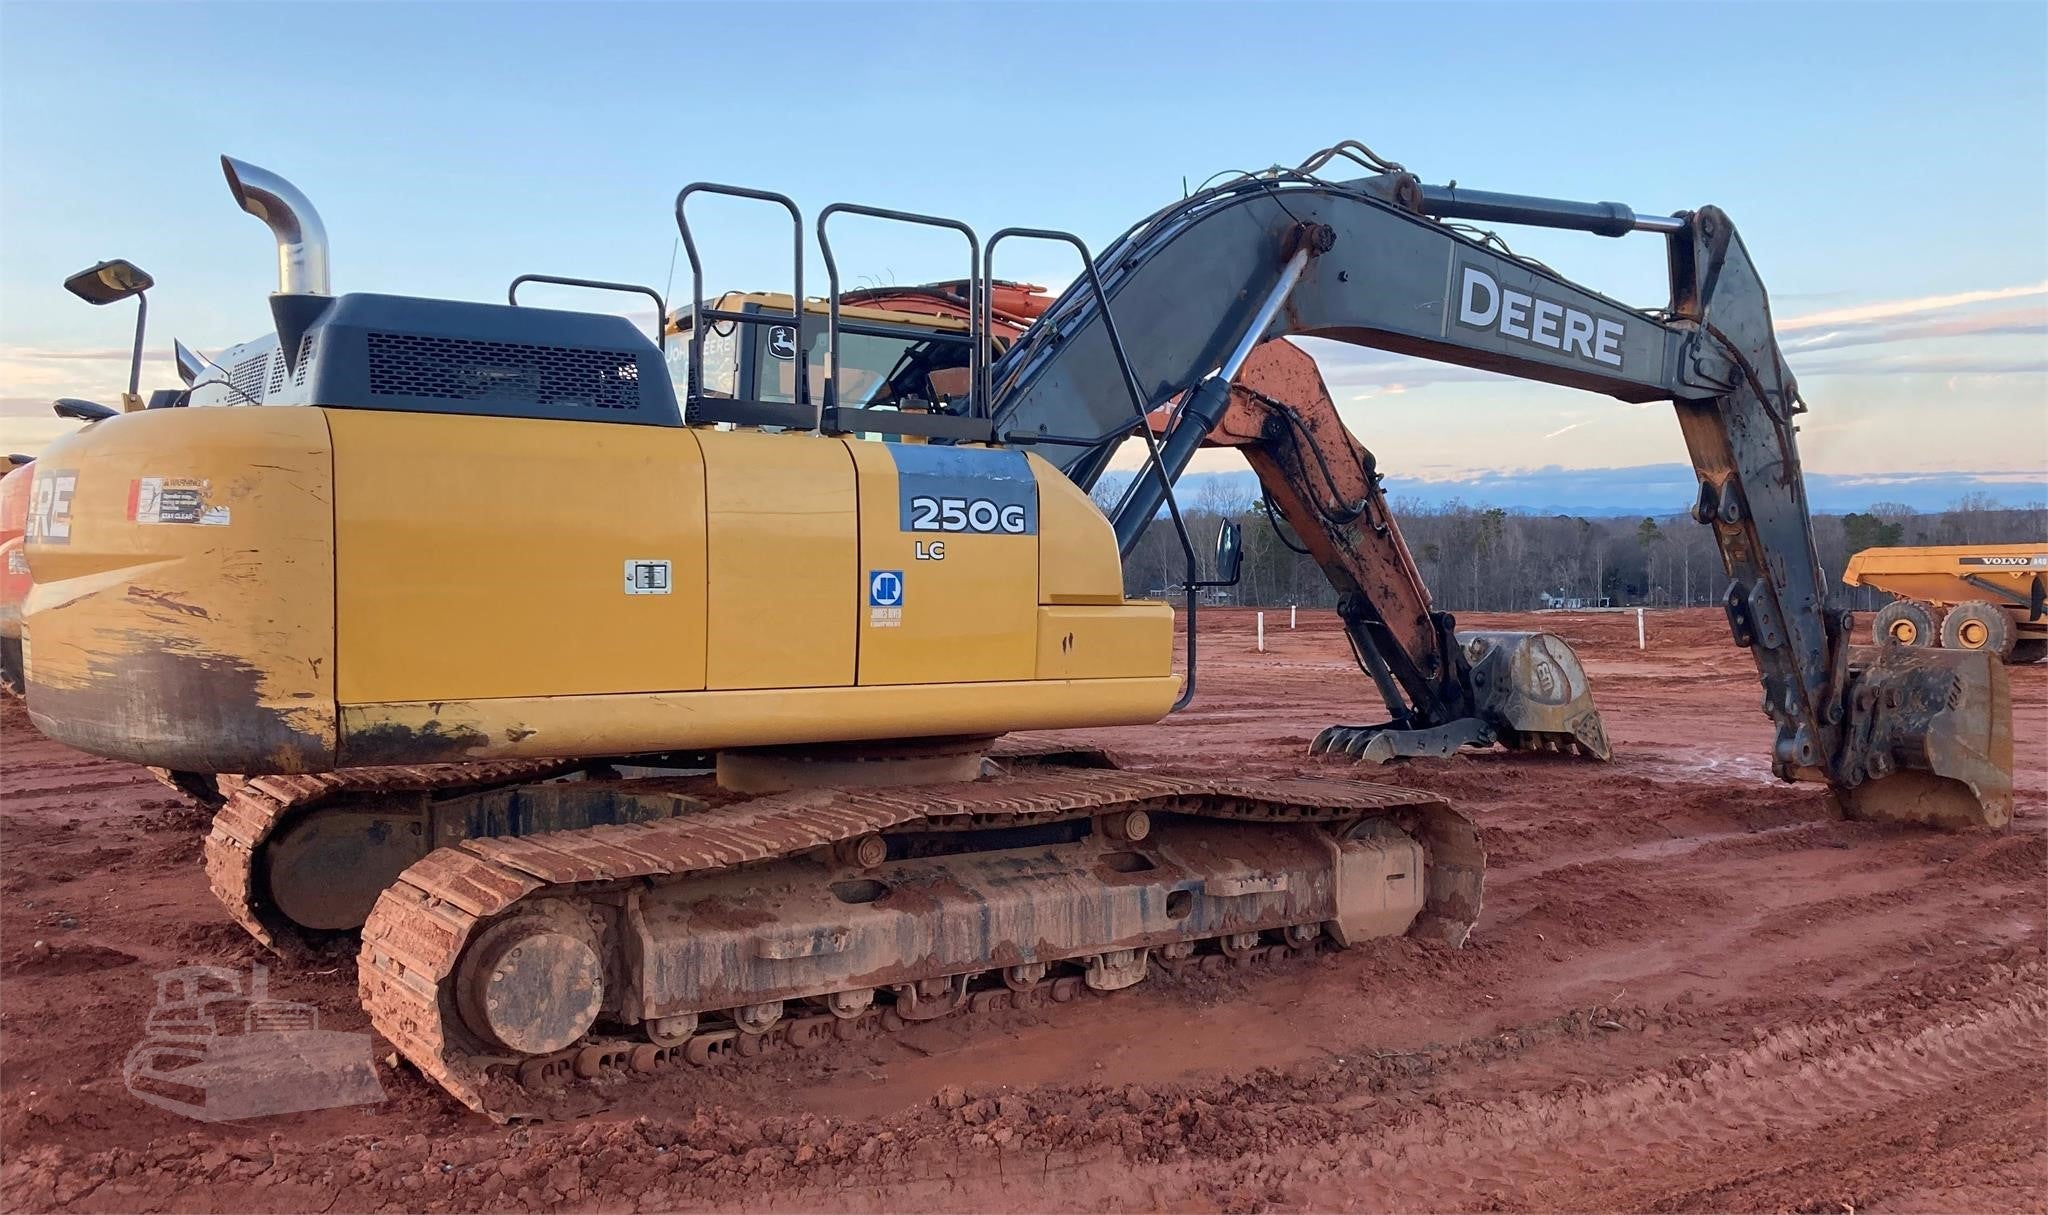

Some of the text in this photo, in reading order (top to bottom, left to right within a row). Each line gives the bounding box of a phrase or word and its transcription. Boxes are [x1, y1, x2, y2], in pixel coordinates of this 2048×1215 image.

[1459, 266, 1625, 366] DEERE
[665, 338, 731, 363] JOH EERE
[912, 497, 1026, 534] 250G
[915, 541, 945, 560] LC
[1982, 557, 2028, 565] VOLVO
